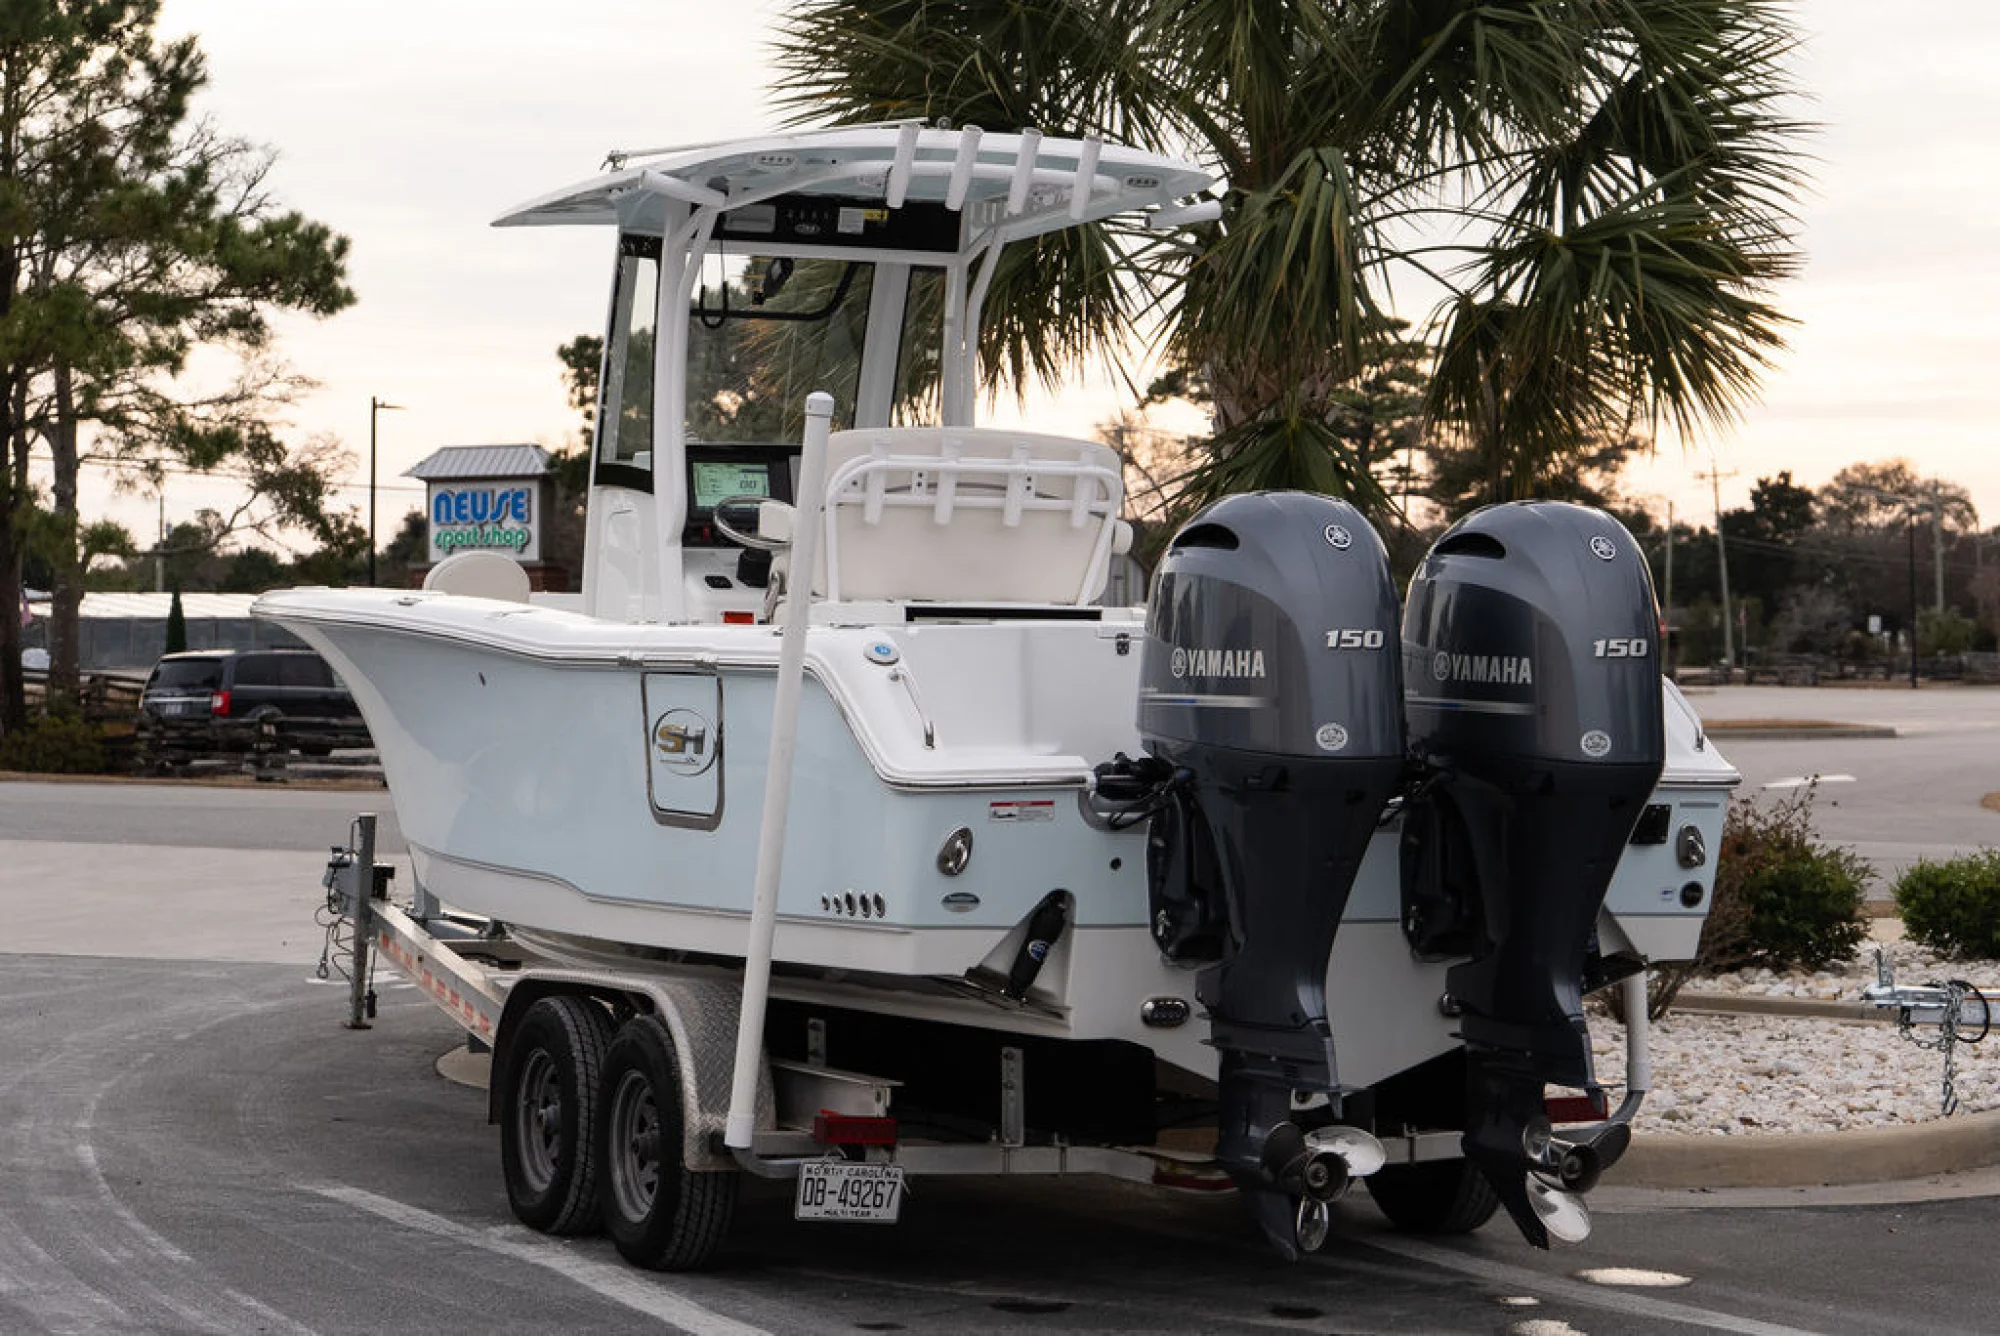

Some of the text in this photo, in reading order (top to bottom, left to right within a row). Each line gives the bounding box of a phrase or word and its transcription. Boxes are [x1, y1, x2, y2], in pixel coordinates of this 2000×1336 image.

[434, 489, 526, 524] NEUSE
[1326, 630, 1384, 648] 150
[1594, 639, 1648, 657] 150
[1188, 650, 1266, 678] YAMAHA
[1453, 656, 1532, 684] YAMAHA
